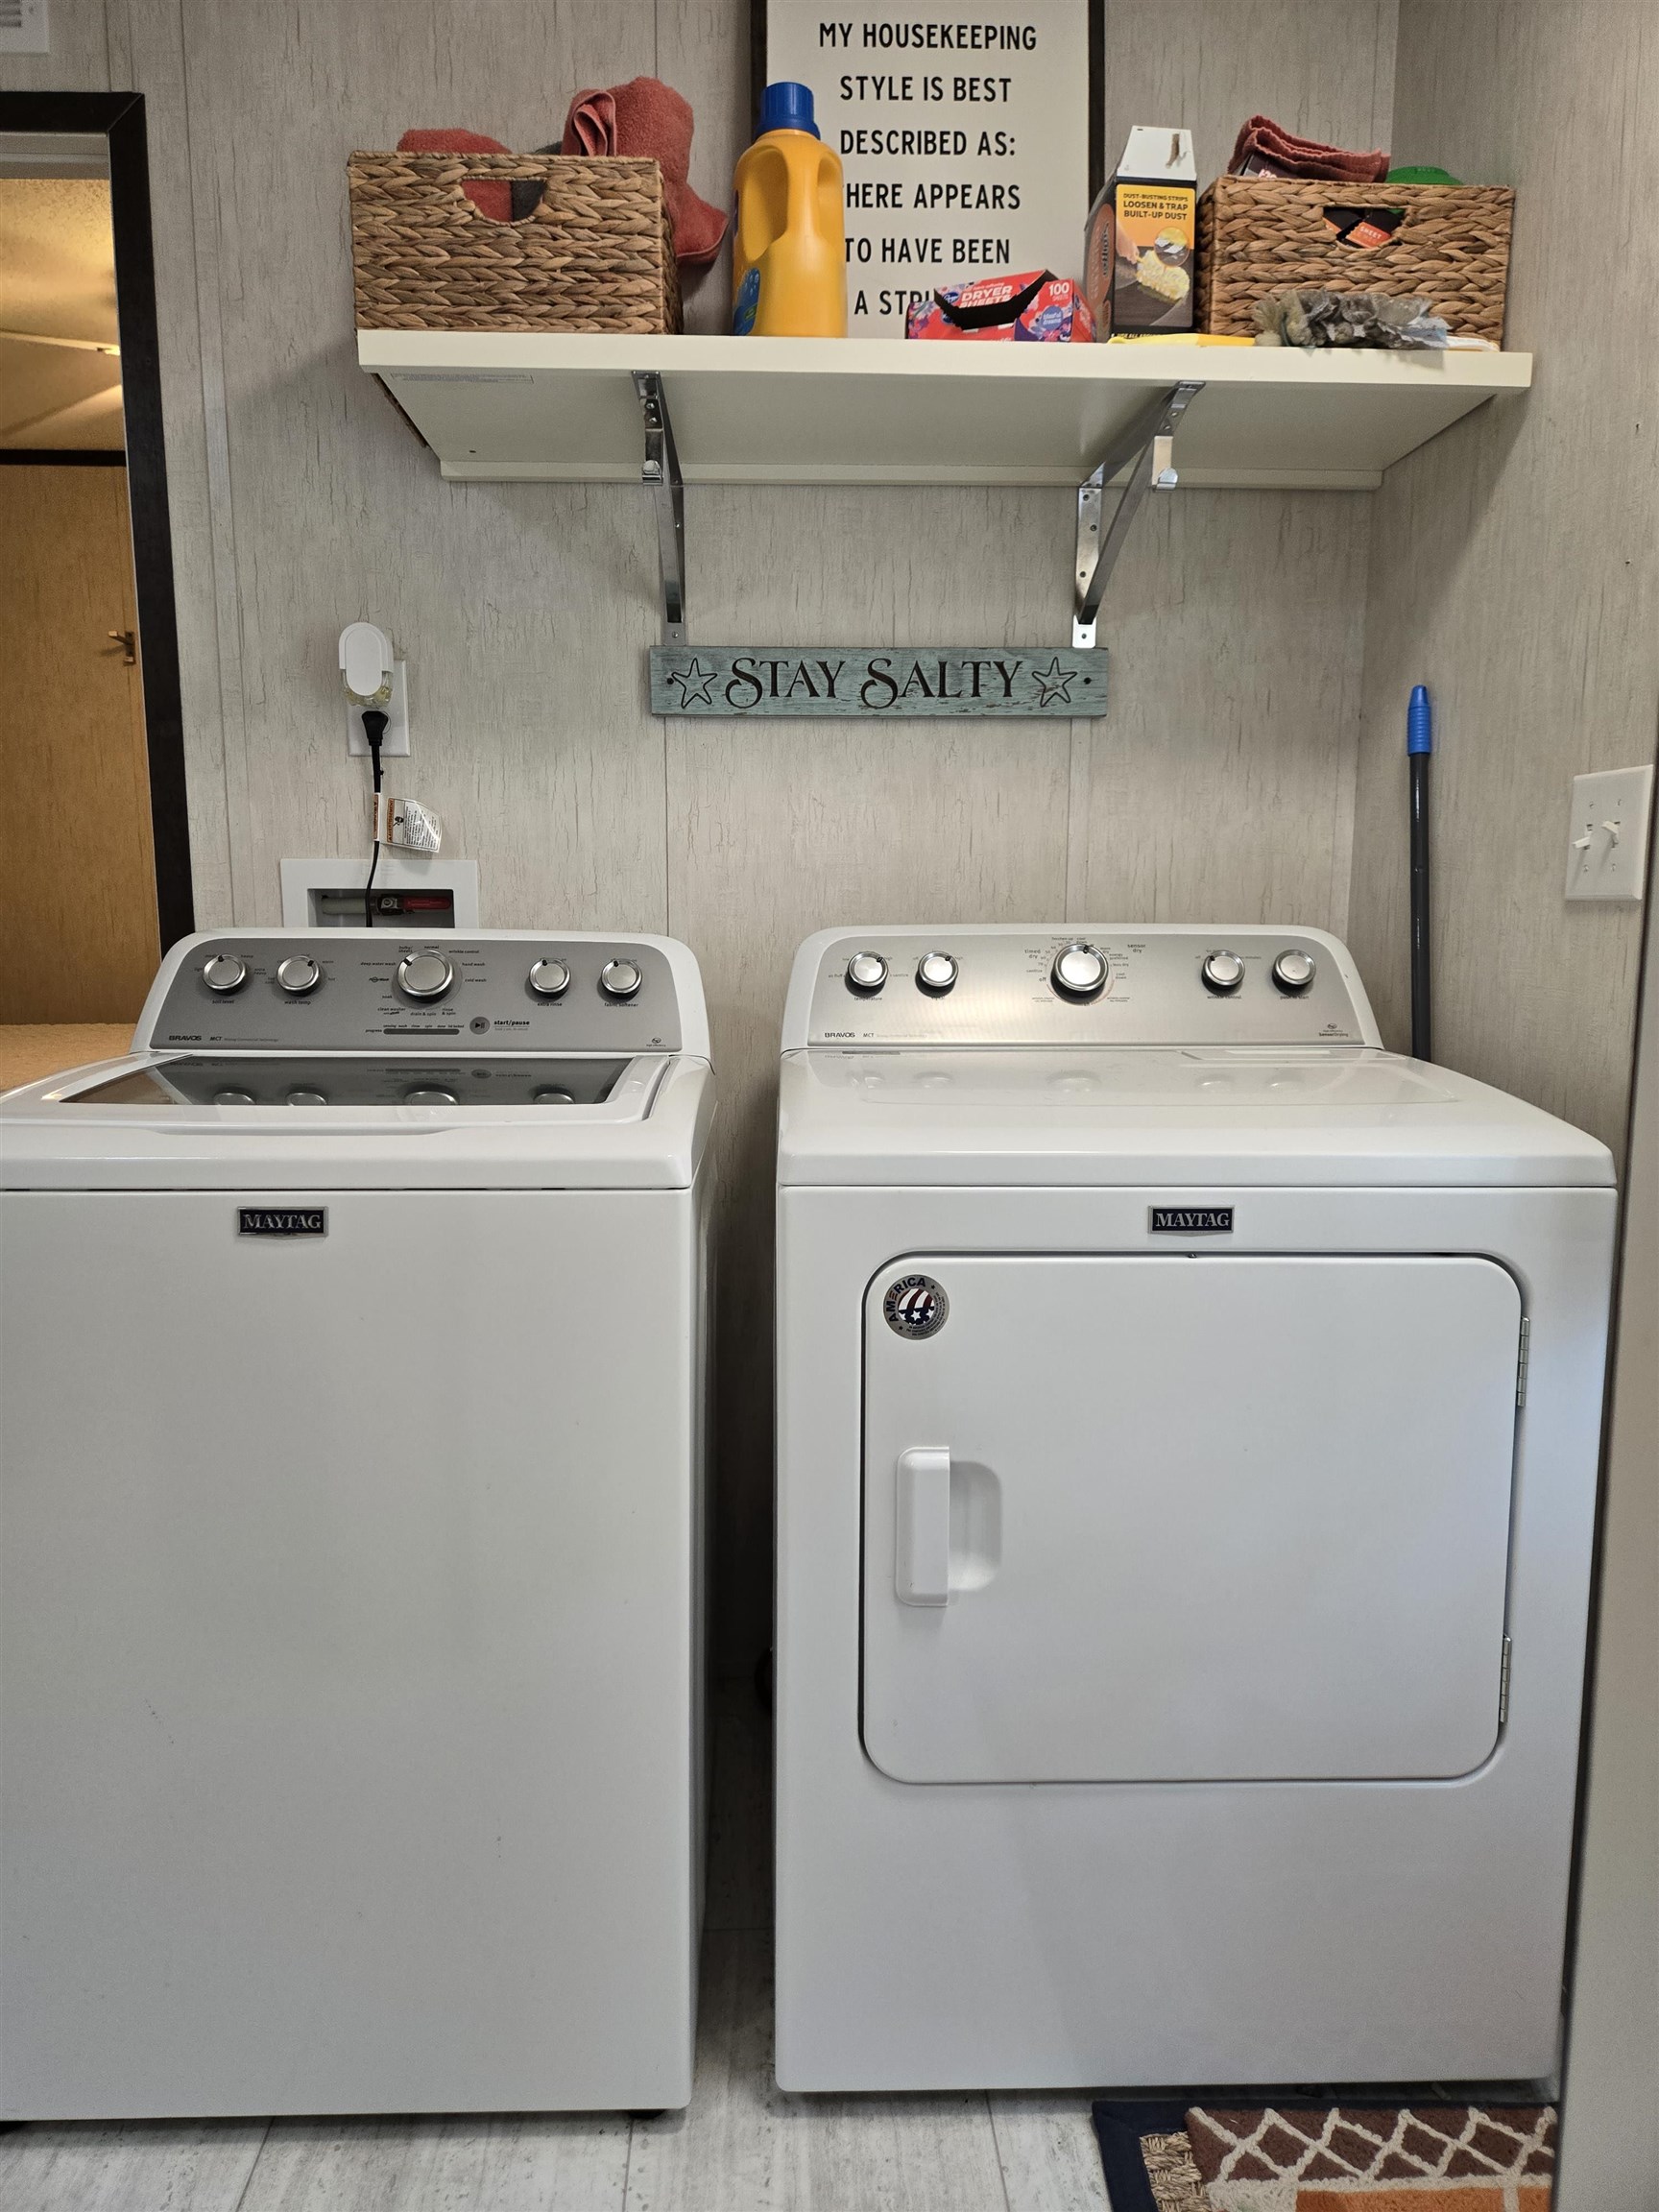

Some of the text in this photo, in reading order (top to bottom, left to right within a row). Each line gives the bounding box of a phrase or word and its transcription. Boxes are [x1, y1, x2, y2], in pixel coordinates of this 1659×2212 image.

[819, 23, 1037, 51] MY HOUSEKEEPING
[840, 76, 1012, 103] STYLE IS BEST
[840, 130, 1016, 156] DESCRIBED AS:
[845, 182, 1021, 210] HERE APPEARS
[1123, 201, 1157, 209] LOOSEN
[1123, 210, 1164, 219] BUILT-UP
[845, 237, 1010, 264] TO HAVE BEEN
[962, 285, 1013, 301] DRYER
[1049, 281, 1070, 297] 100
[854, 290, 869, 315] A
[726, 657, 1023, 709] STAY SALTY
[243, 1214, 322, 1229] MAYTAG
[1155, 1213, 1230, 1227] MAYTAG
[886, 1277, 926, 1322] AMERICA
